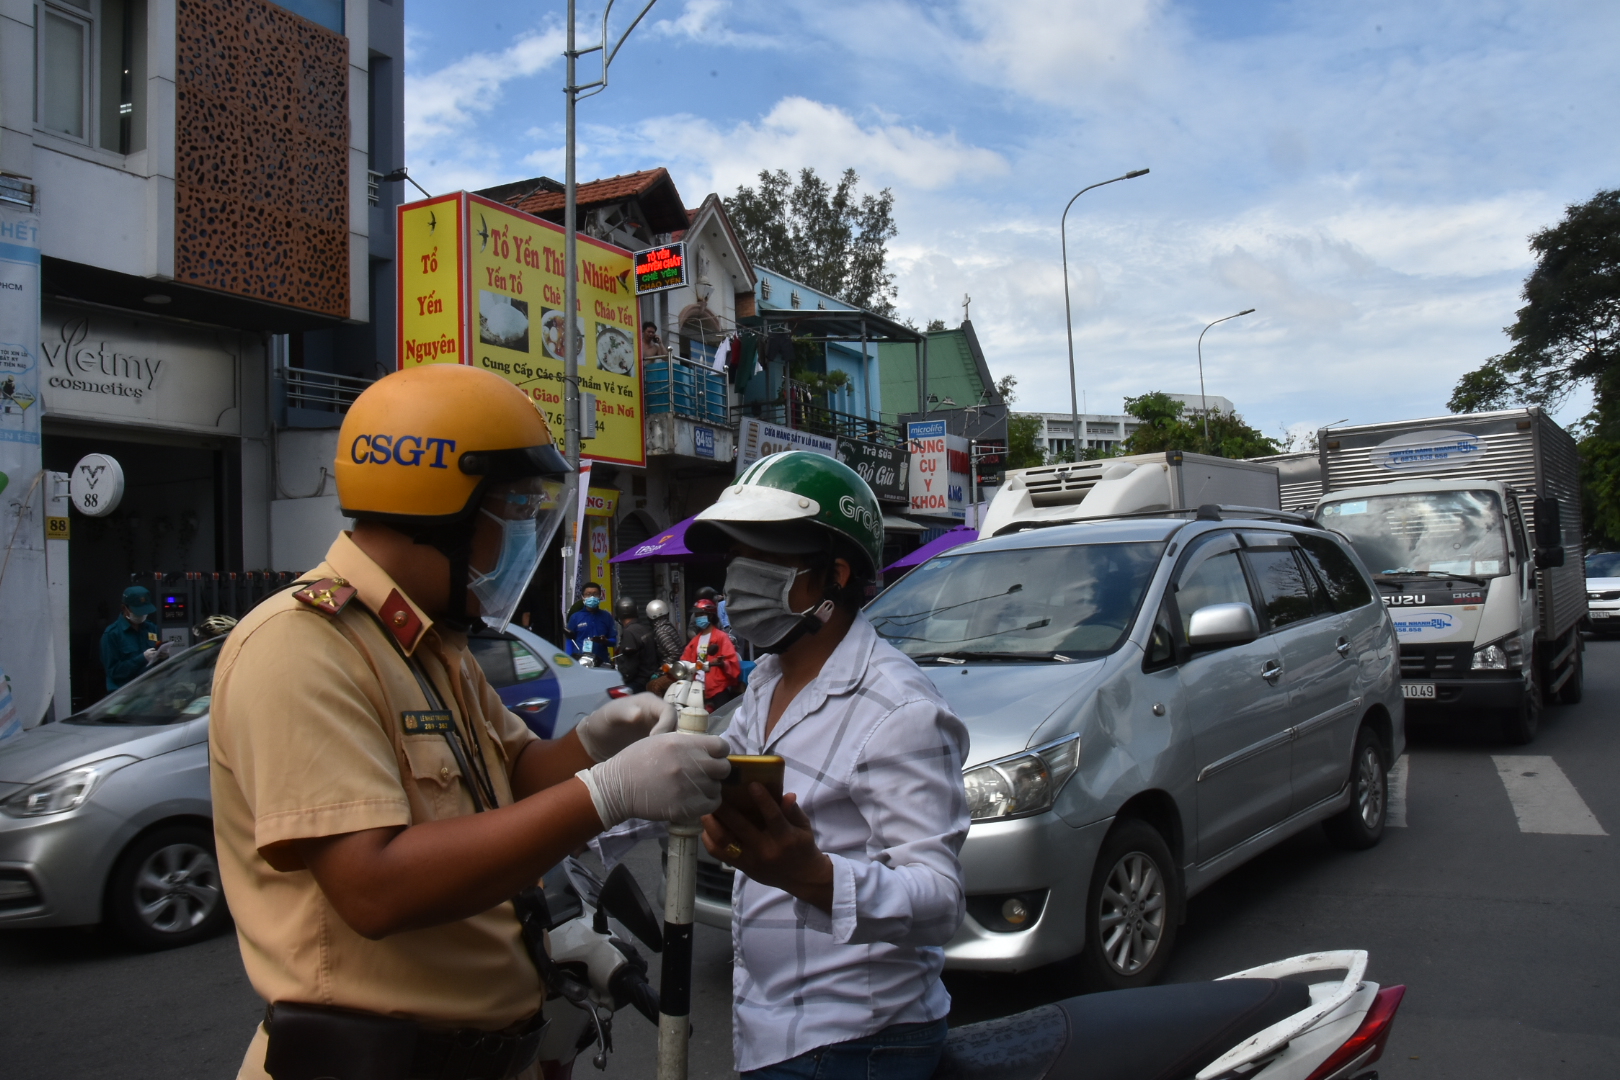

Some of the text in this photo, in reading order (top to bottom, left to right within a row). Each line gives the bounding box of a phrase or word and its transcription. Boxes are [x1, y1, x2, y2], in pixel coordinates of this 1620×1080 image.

[1, 220, 37, 242] HẾT
[421, 246, 438, 274] Tổ
[491, 224, 510, 259] Tổ
[513, 236, 540, 269] Yến
[582, 259, 617, 294] Nhiên
[486, 266, 523, 295] Yến Tổ
[417, 290, 442, 316] Yến
[543, 284, 561, 306] Chè
[594, 300, 616, 322] Cháo
[617, 308, 633, 327] Yến
[406, 333, 456, 364] Nguyên
[49, 375, 143, 399] cosmetics
[482, 356, 510, 374] Cung
[513, 363, 533, 379] Cấp
[577, 376, 602, 391] Phẩm
[604, 381, 615, 394] Về
[617, 384, 633, 398] Yến
[533, 387, 560, 404] Giao
[617, 405, 635, 418] Nơi
[696, 430, 705, 447] 84
[911, 424, 943, 434] microlife
[351, 434, 456, 469] CSGT
[862, 446, 876, 457] Trà
[911, 438, 945, 458] DỤNG
[875, 466, 895, 486] Già
[919, 459, 936, 476] CỤ
[924, 478, 932, 492] Y
[84, 493, 98, 508] 88
[585, 496, 604, 508] NG
[911, 495, 946, 510] KHOA
[50, 519, 66, 531] 88
[839, 495, 881, 539] Grab
[592, 532, 608, 553] 25%
[1381, 595, 1426, 605] SUZU
[1402, 686, 1434, 697] 10.49
